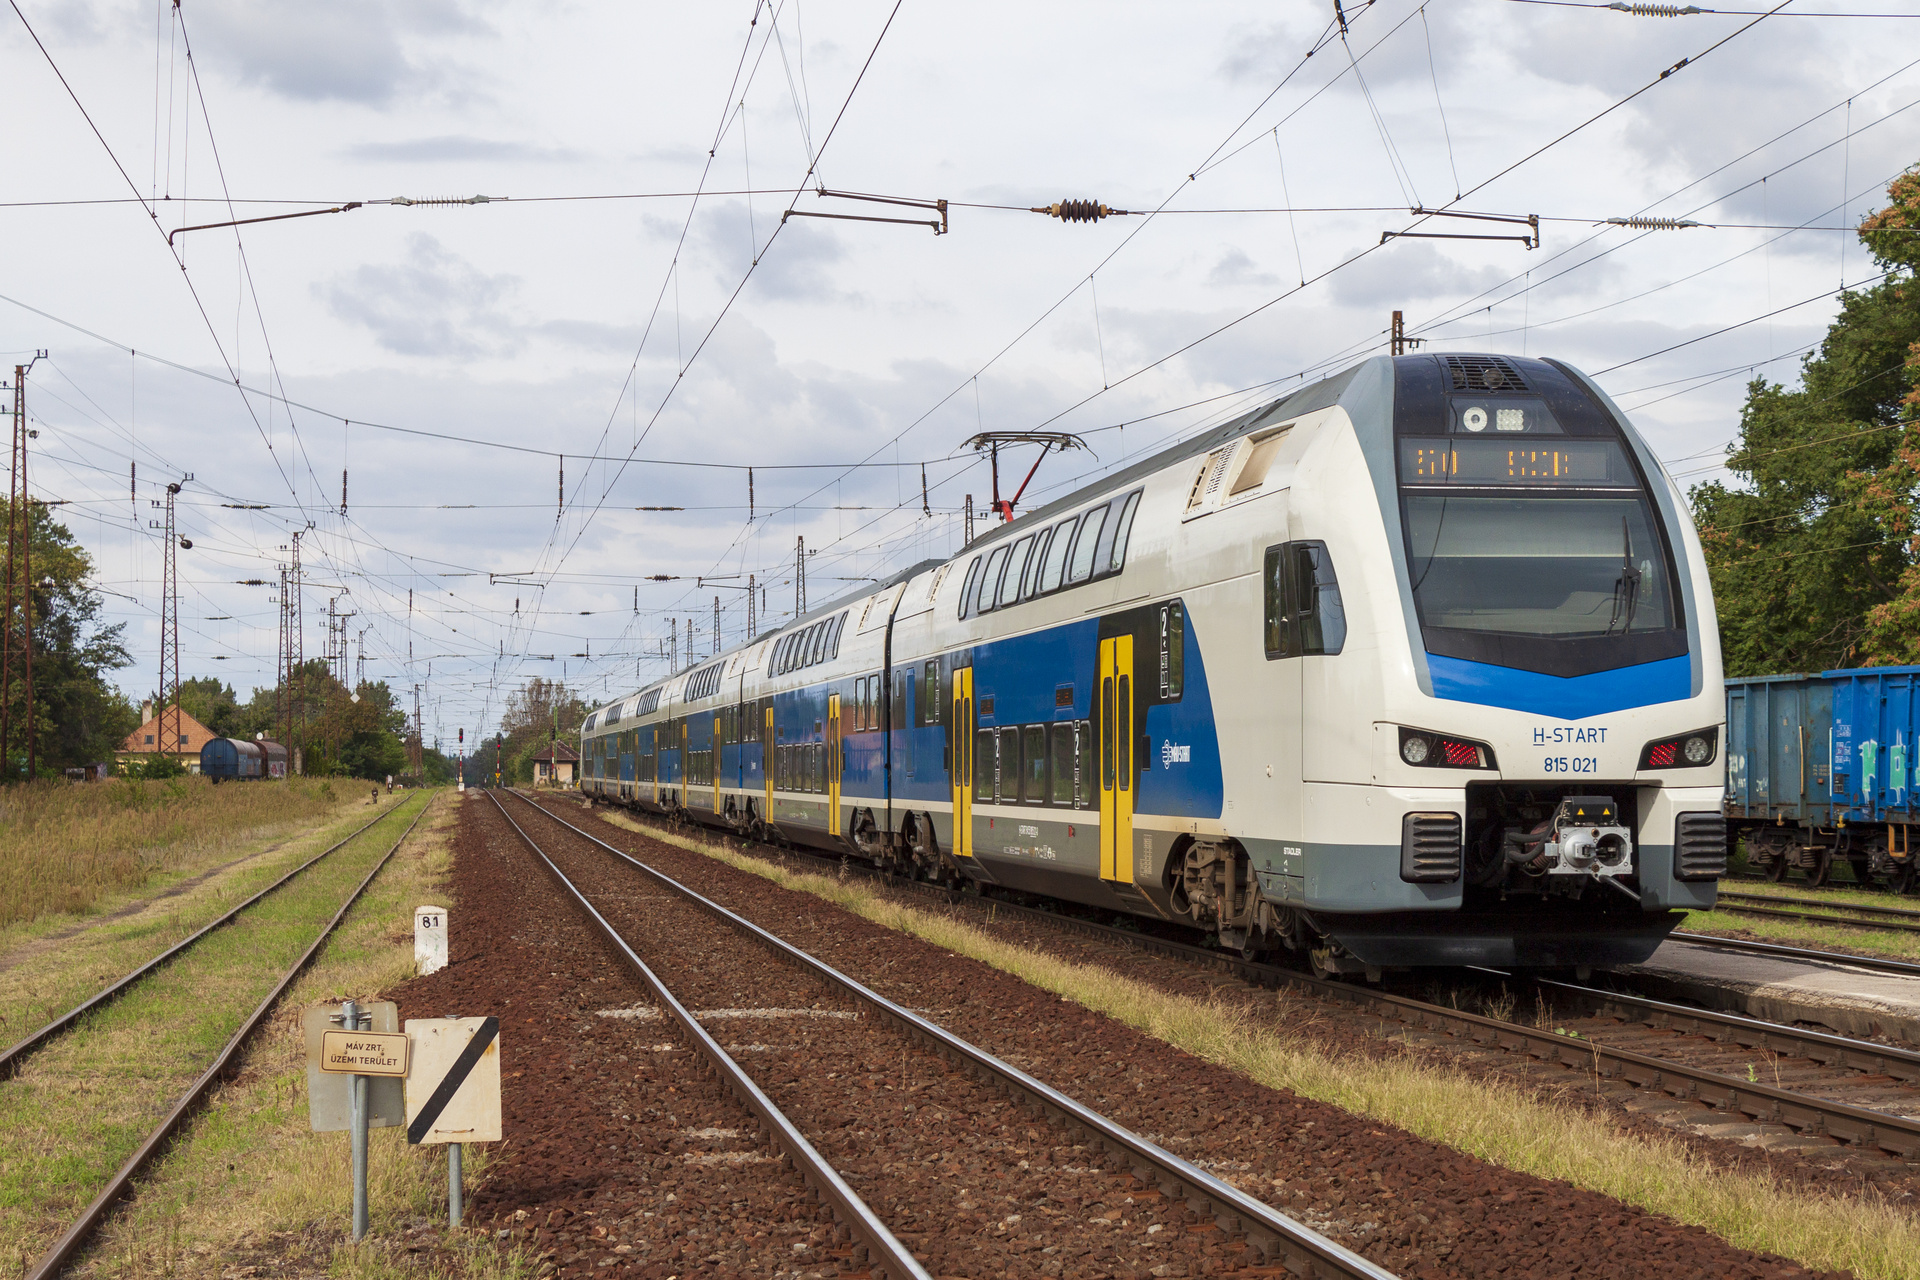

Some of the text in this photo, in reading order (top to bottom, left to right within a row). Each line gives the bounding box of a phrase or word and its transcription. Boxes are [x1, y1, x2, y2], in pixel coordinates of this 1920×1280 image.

[1161, 611, 1167, 637] 2
[1533, 727, 1608, 745] H-START
[1544, 757, 1597, 773] 815 021
[1283, 846, 1302, 856] STADLER
[422, 916, 439, 928] 81
[345, 1041, 364, 1050] MÁV
[330, 1053, 398, 1066] ÜZEMI TERÜLET
